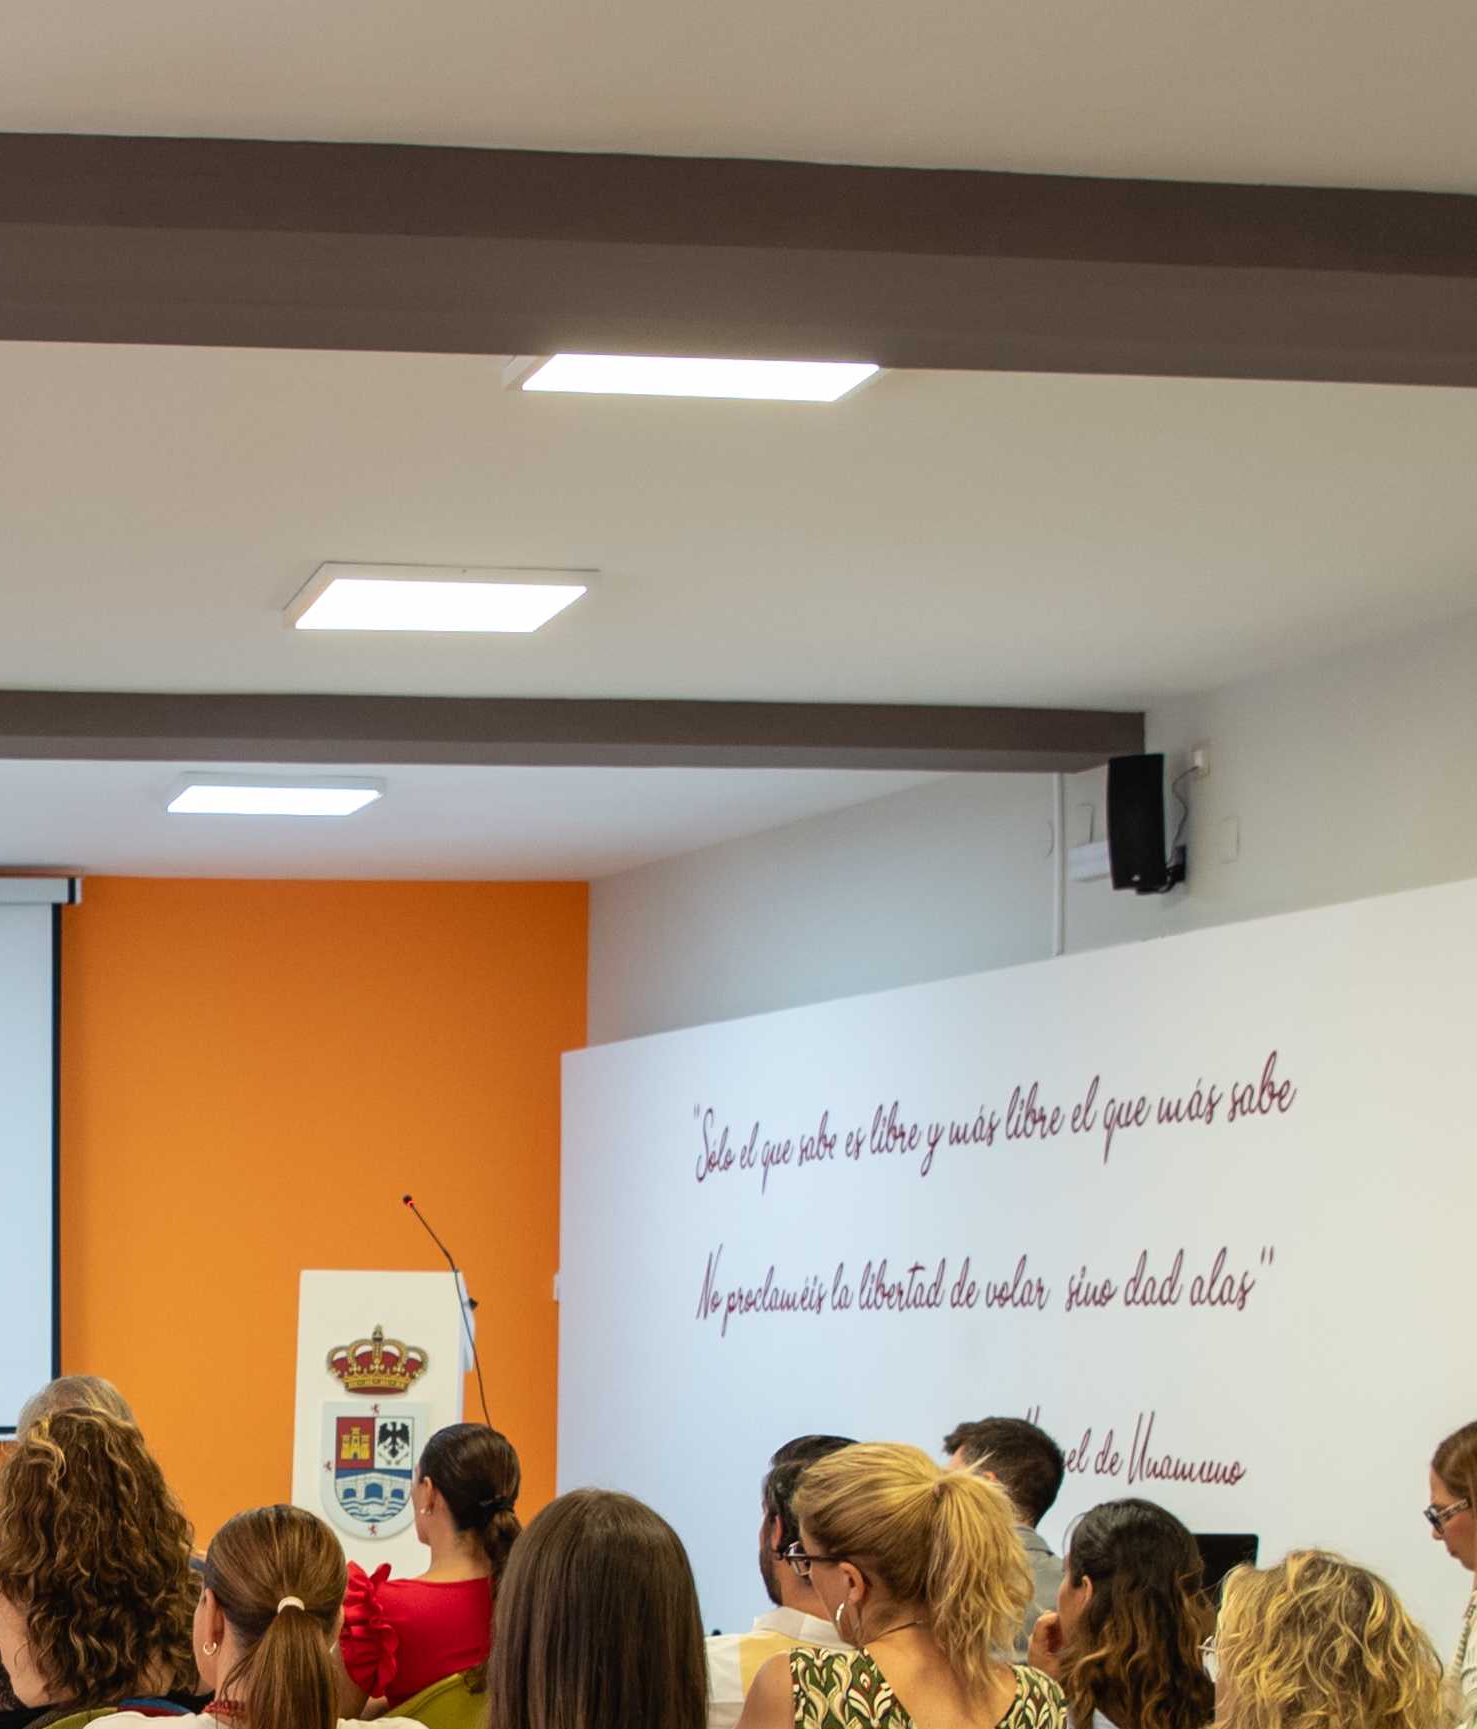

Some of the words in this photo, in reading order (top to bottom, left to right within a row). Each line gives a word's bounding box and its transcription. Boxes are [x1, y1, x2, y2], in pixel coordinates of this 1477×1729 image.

[739, 1120, 760, 1171] el
[761, 1139, 793, 1195] que
[798, 1110, 838, 1166] sabe
[845, 1127, 867, 1160] es
[870, 1100, 921, 1155] libre
[921, 1124, 945, 1177] y
[948, 1105, 1002, 1146] más
[1005, 1081, 1065, 1140] libre
[1071, 1074, 1100, 1133] el
[1103, 1095, 1152, 1164] que
[1157, 1078, 1223, 1125] más
[1227, 1050, 1298, 1123] sabe
[696, 1243, 724, 1320] No
[721, 1265, 828, 1338] proclaméis
[831, 1261, 854, 1311] la
[858, 1257, 946, 1312] libertad
[950, 1256, 980, 1309] de
[986, 1253, 1050, 1311] volar
[1065, 1265, 1118, 1312] sino
[1123, 1248, 1184, 1308] dad
[1094, 1428, 1124, 1477] de
[1127, 1410, 1246, 1486] Unamuno
